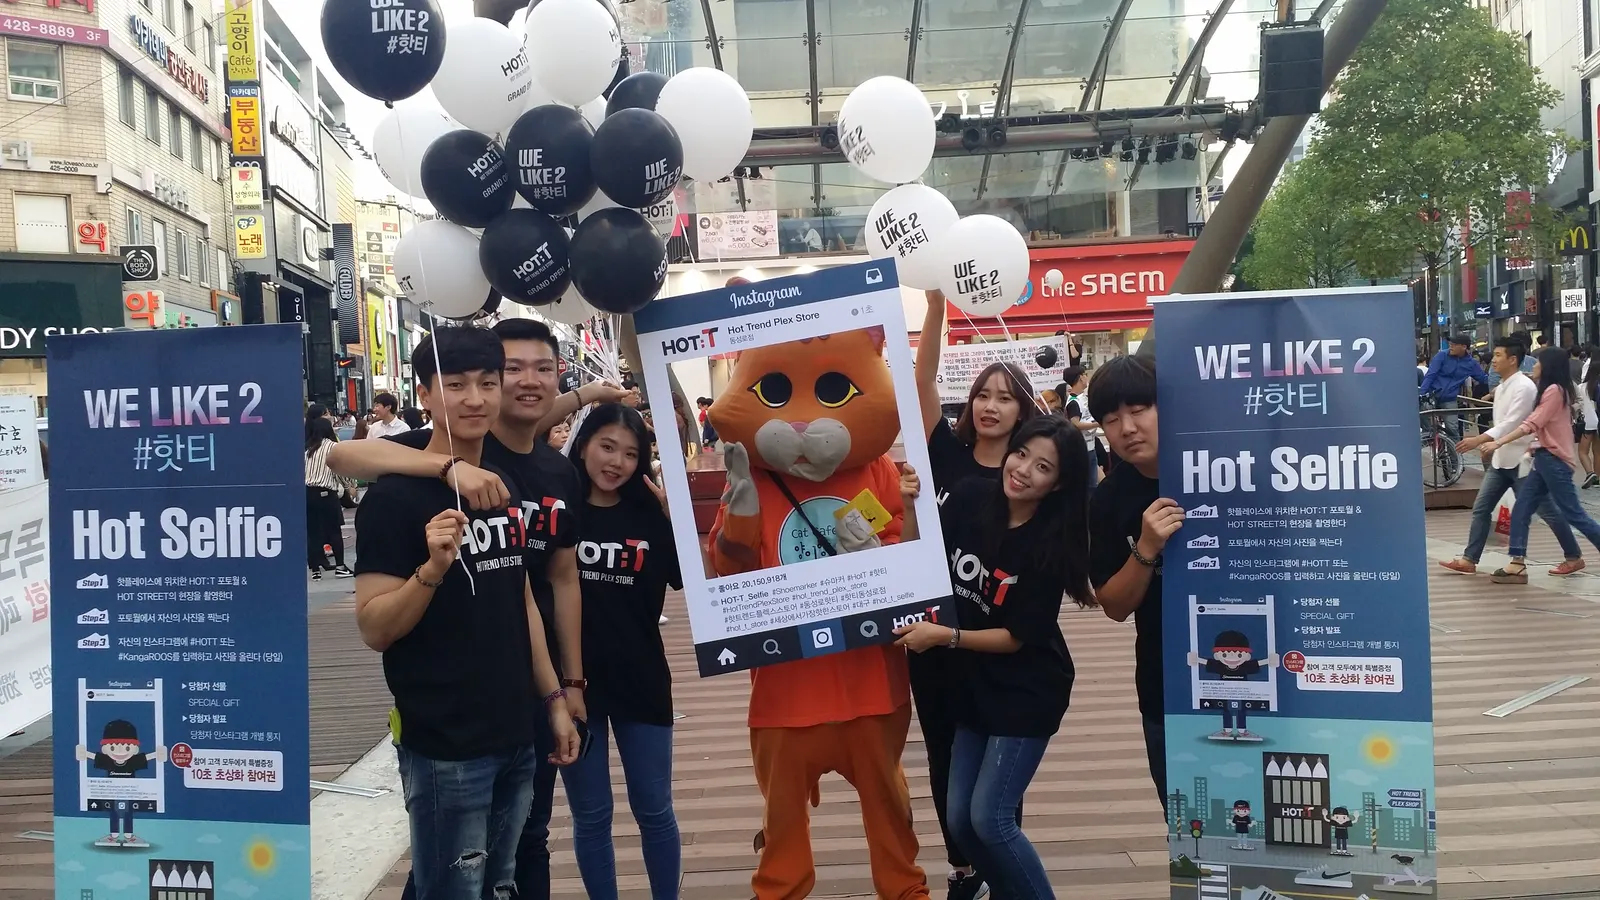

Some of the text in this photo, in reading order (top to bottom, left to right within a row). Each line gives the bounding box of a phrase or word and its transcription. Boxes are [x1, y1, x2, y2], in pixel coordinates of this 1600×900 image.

[3, 19, 101, 41] 428-8889 3F
[371, 9, 416, 33] LIKE
[230, 13, 251, 54] 고양이
[387, 33, 428, 56] #핫티
[231, 88, 258, 96] 아카데미
[507, 84, 528, 101] GRAND
[235, 100, 258, 152] 부동산
[467, 143, 500, 178] HOT:T
[518, 148, 543, 167] WE
[520, 167, 553, 185] LIKE
[554, 166, 566, 184] 2
[644, 158, 668, 181] WE
[105, 182, 113, 196] 2
[482, 178, 504, 198] GRAND
[533, 185, 567, 200] #핫티
[644, 173, 675, 195] LIKE
[875, 208, 897, 234] WE
[880, 212, 922, 251] LIKE 2
[78, 222, 108, 252] 약
[239, 234, 263, 246] 노래
[898, 228, 930, 258] #핫티
[512, 241, 552, 280] HOT:T
[954, 259, 977, 279] WE
[338, 268, 354, 301] FOLDER
[527, 279, 550, 296] GRAND
[549, 266, 566, 282] OPEN
[956, 269, 1001, 295] LIKE 2
[1081, 270, 1166, 297] SAEM
[729, 284, 803, 309] Instagram
[971, 285, 1003, 305] #핫티
[125, 291, 160, 326] 약
[860, 304, 874, 314] 1초
[727, 311, 820, 336] Hot Trend Plex Store
[661, 326, 719, 356] HOT:T
[729, 334, 755, 345] 동성로점
[1194, 337, 1377, 381] WE LIKE 2
[83, 382, 263, 429] WE LIKE 2
[1243, 381, 1328, 417] #핫티
[133, 432, 216, 472] #핫티
[1182, 444, 1398, 494] Hot Selfie
[72, 506, 282, 560] Hot Selfie
[791, 524, 836, 539] Cat afe
[528, 538, 547, 551] STORE
[581, 570, 635, 586] TREND PLEX STORE
[718, 582, 740, 593] 좋아요
[772, 582, 818, 595] #Shoemarker
[820, 575, 845, 586] #슈마커
[847, 571, 867, 581] #HotT
[869, 567, 888, 577] #핫티
[117, 591, 233, 601] HOT STREET의 현장을 촬영한다
[954, 583, 971, 599] TREND
[722, 595, 790, 614] #HotTrendPlexStore
[724, 586, 887, 623] #핫트렌드플렉스스토어 #동성로핫티 #핫티동성로점
[726, 591, 915, 633] #hot_t_store #세상에서가장핫한스토어 #대구 #hot_t_selfie
[117, 613, 230, 623] 포토월에서 자신의 사진을 찍는다
[1300, 612, 1355, 621] SPECIAL GIFT
[118, 637, 235, 647] 자신의 인스타그램에 #HOTT 또는
[1303, 673, 1395, 685] 10초 초상화 참여권
[188, 698, 240, 707] SPECIAL GIFT
[190, 730, 281, 742] 당첨자 인스타그램 개별 통지
[191, 768, 276, 783] 10초 초상화 참여권
